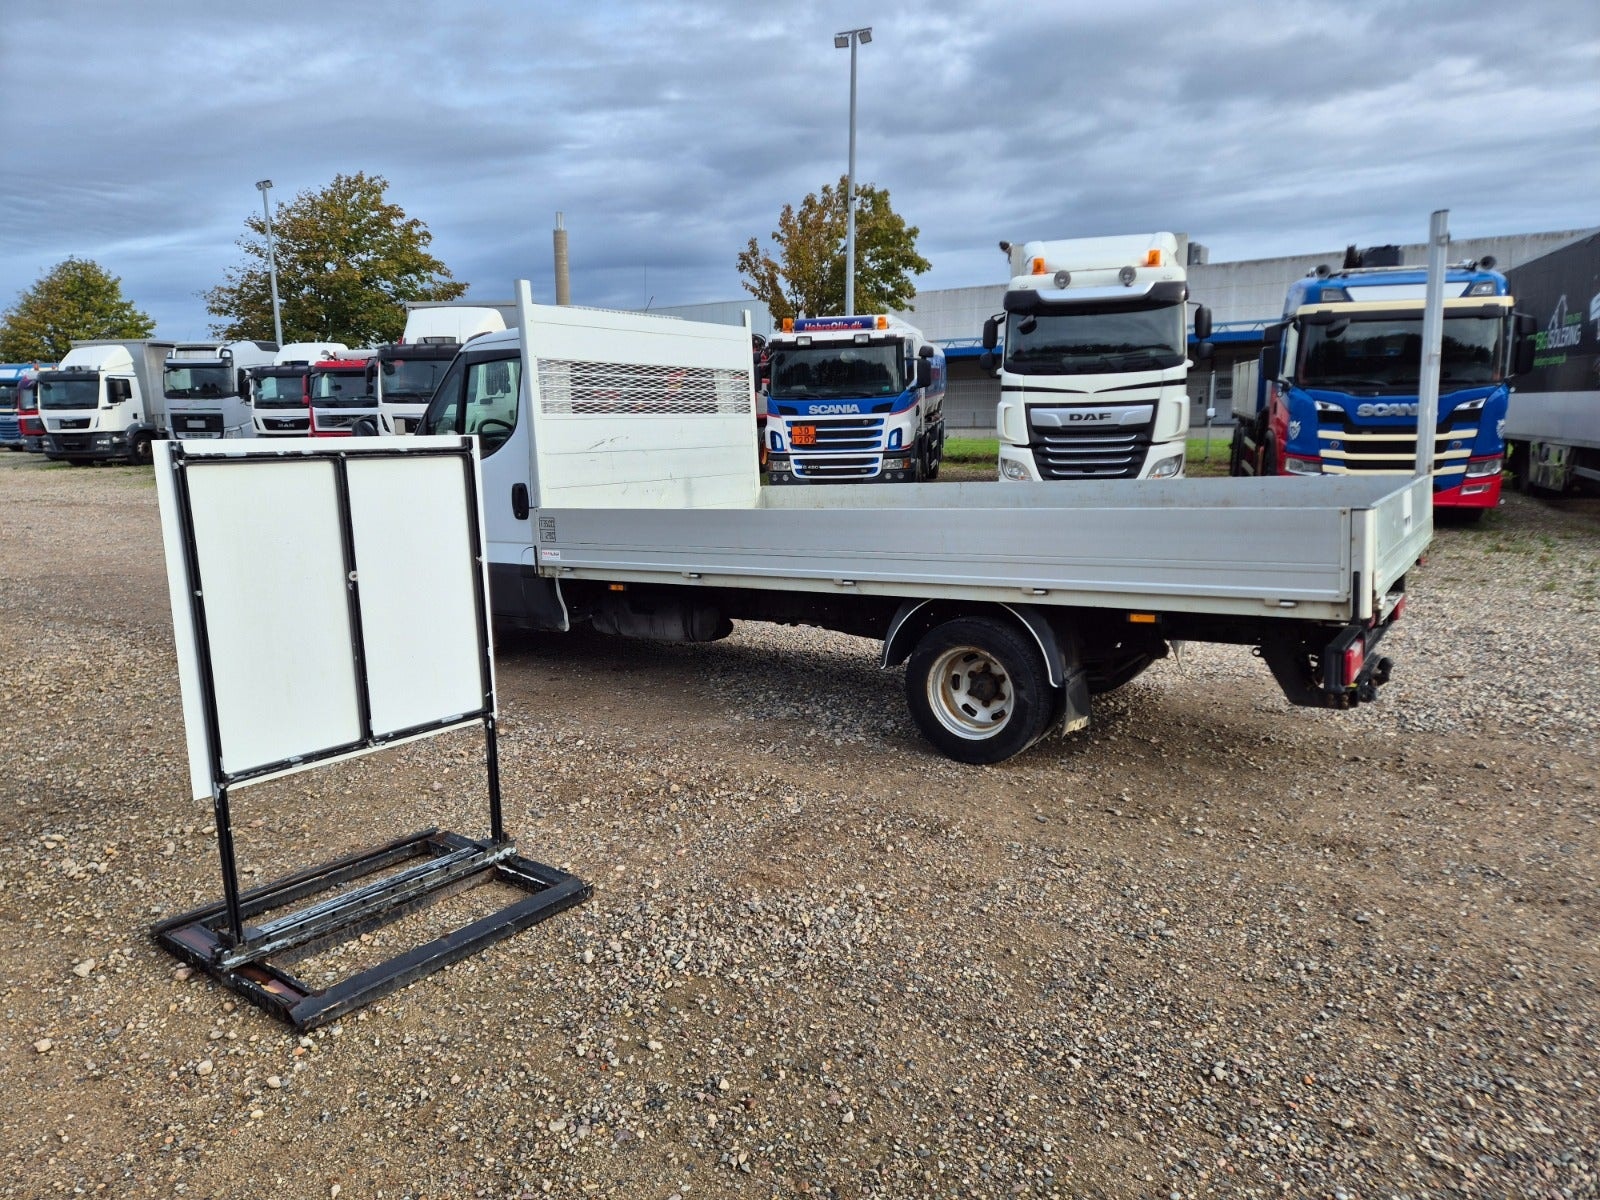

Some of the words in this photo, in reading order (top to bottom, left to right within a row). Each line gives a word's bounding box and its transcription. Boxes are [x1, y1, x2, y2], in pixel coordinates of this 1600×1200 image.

[808, 404, 860, 415] SCANIA
[1356, 403, 1419, 417] SCAN
[1069, 412, 1112, 422] DAF
[798, 427, 810, 435] 30
[793, 436, 815, 444] 1202
